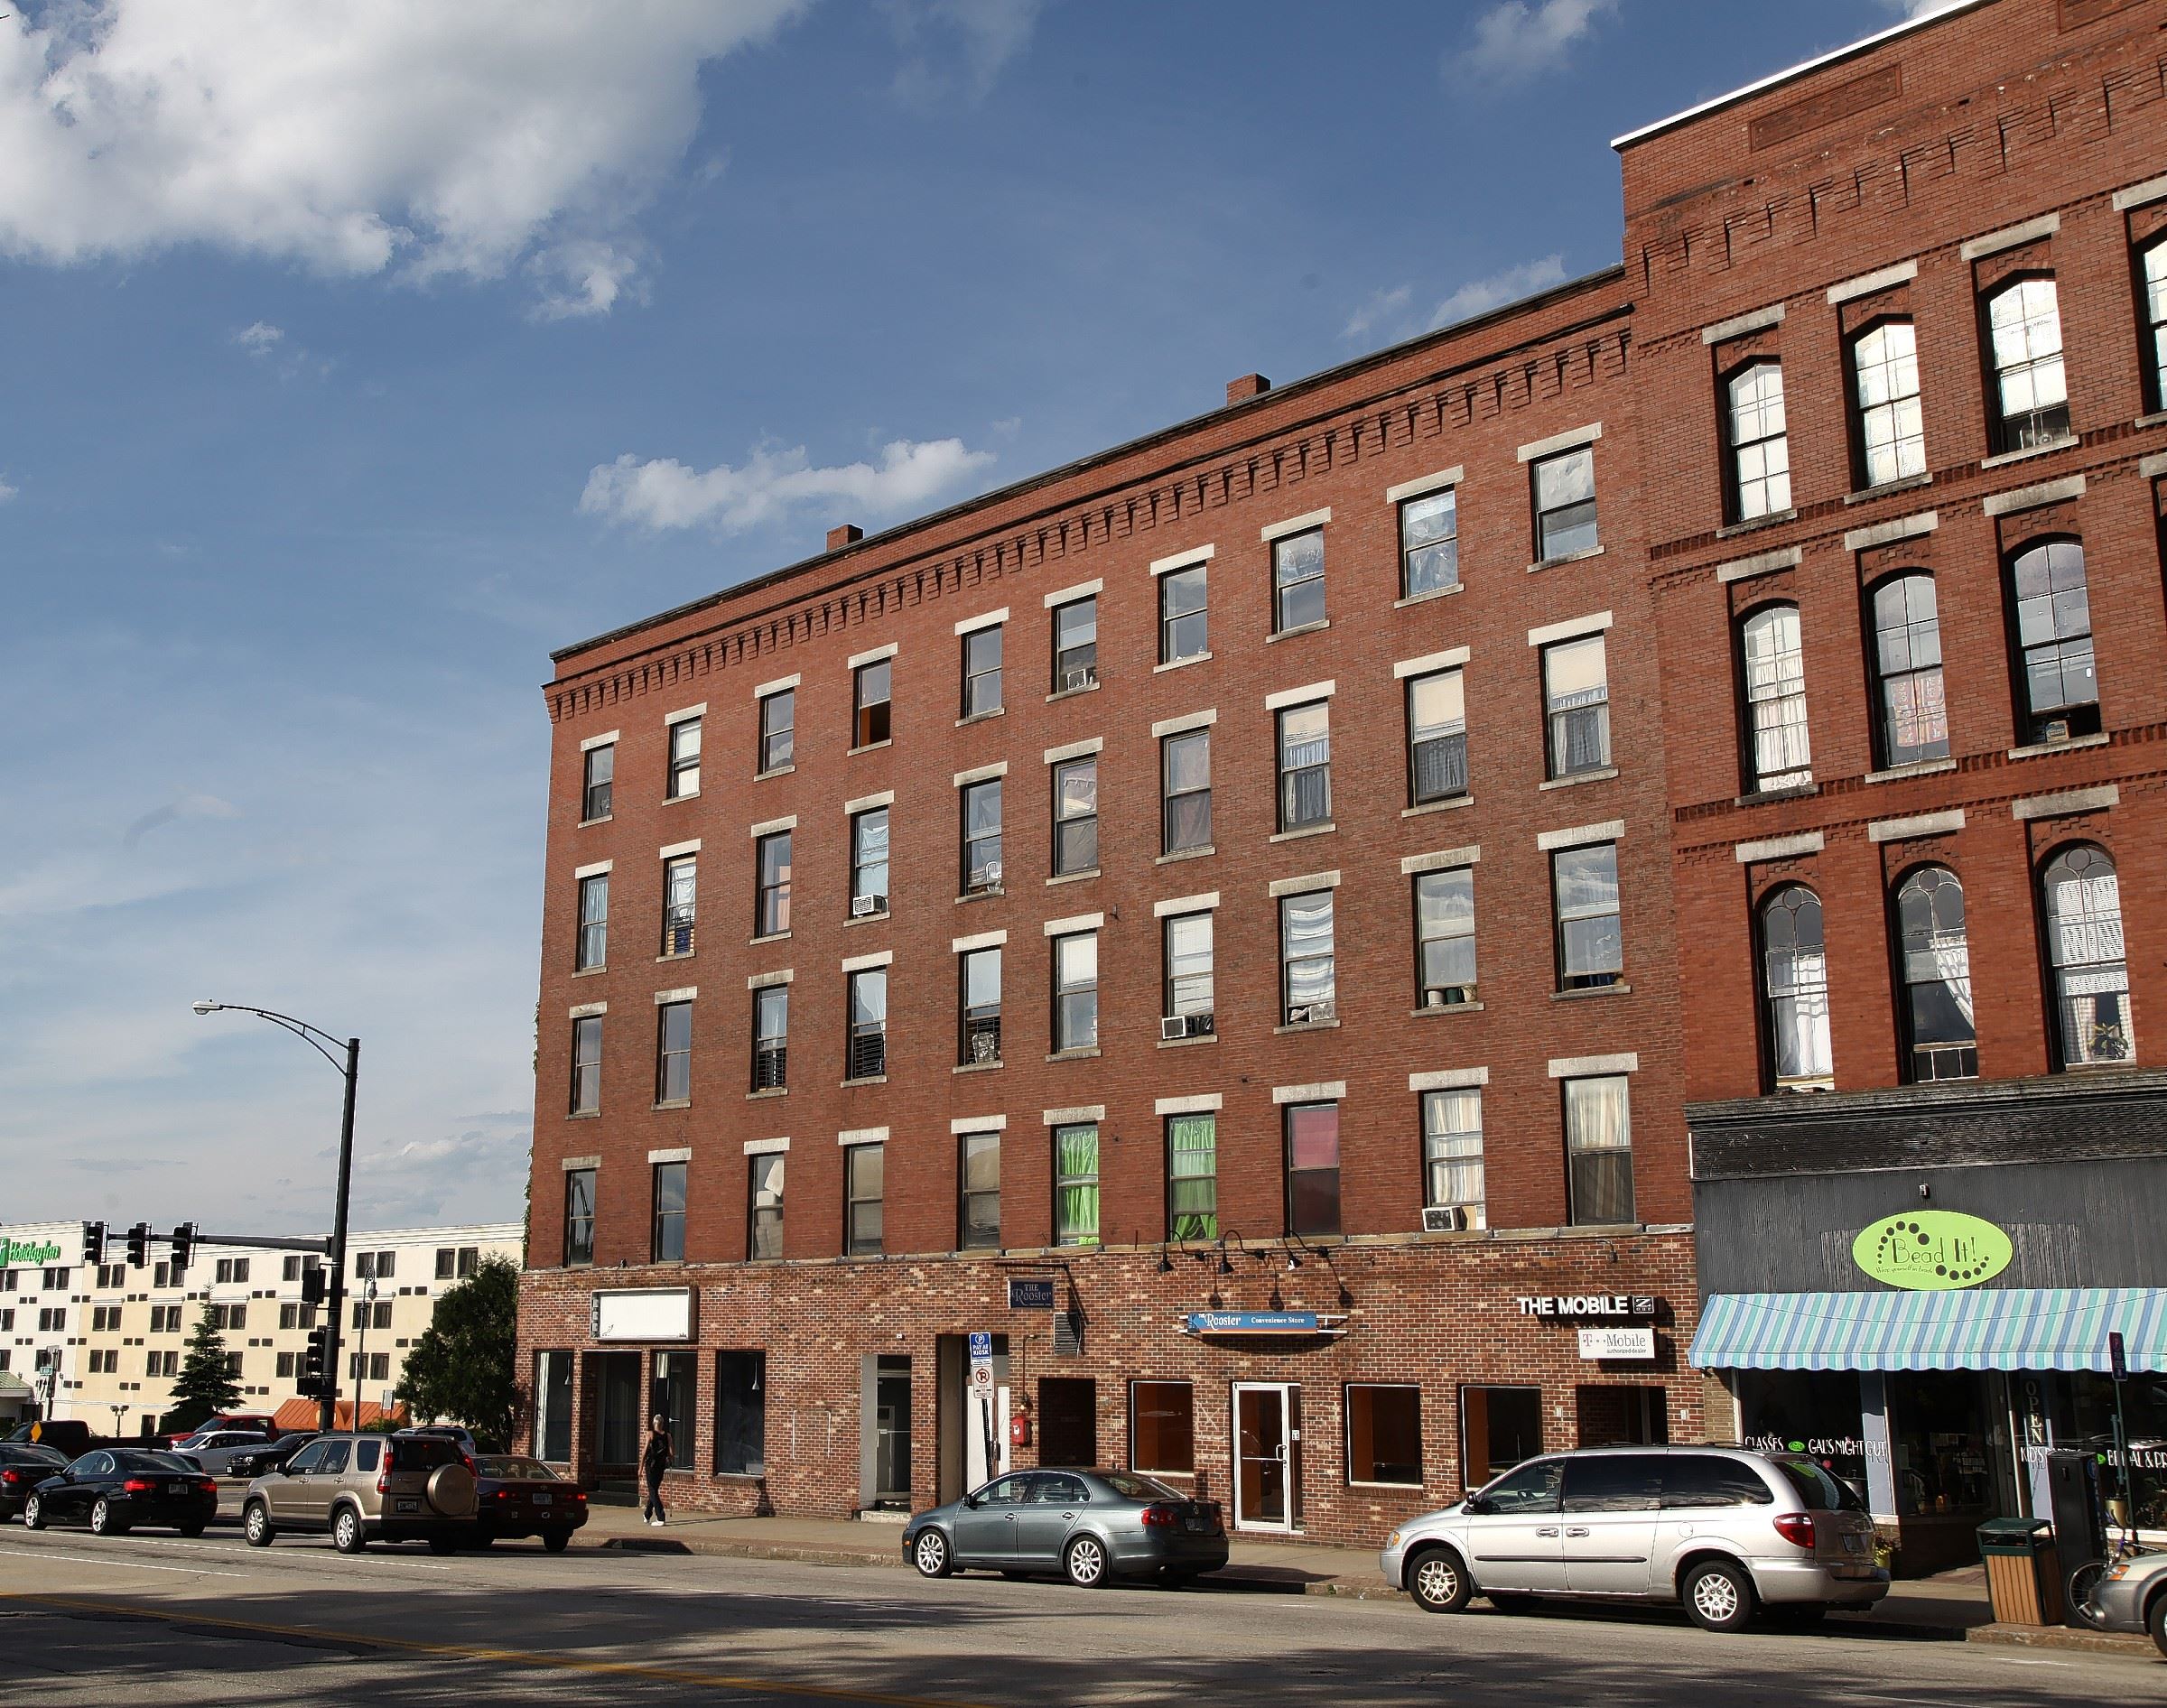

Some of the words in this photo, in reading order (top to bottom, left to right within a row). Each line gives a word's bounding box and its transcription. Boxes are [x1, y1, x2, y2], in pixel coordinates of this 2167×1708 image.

[9, 1241, 43, 1266] Holiday
[43, 1240, 60, 1261] Inn
[1893, 1237, 1944, 1264] Bead
[1954, 1237, 1977, 1263] It!
[1011, 1289, 1051, 1306] Rooster
[1517, 1296, 1555, 1314] THE
[1558, 1296, 1629, 1314] MOBILE
[1204, 1313, 1242, 1331] Rooster
[2025, 1380, 2043, 1443] OPEN
[1745, 1436, 1783, 1451] CLASSES
[1809, 1439, 1834, 1454] GAL'S
[1835, 1440, 1864, 1455] NIGHT
[2020, 1446, 2044, 1462] KID'S
